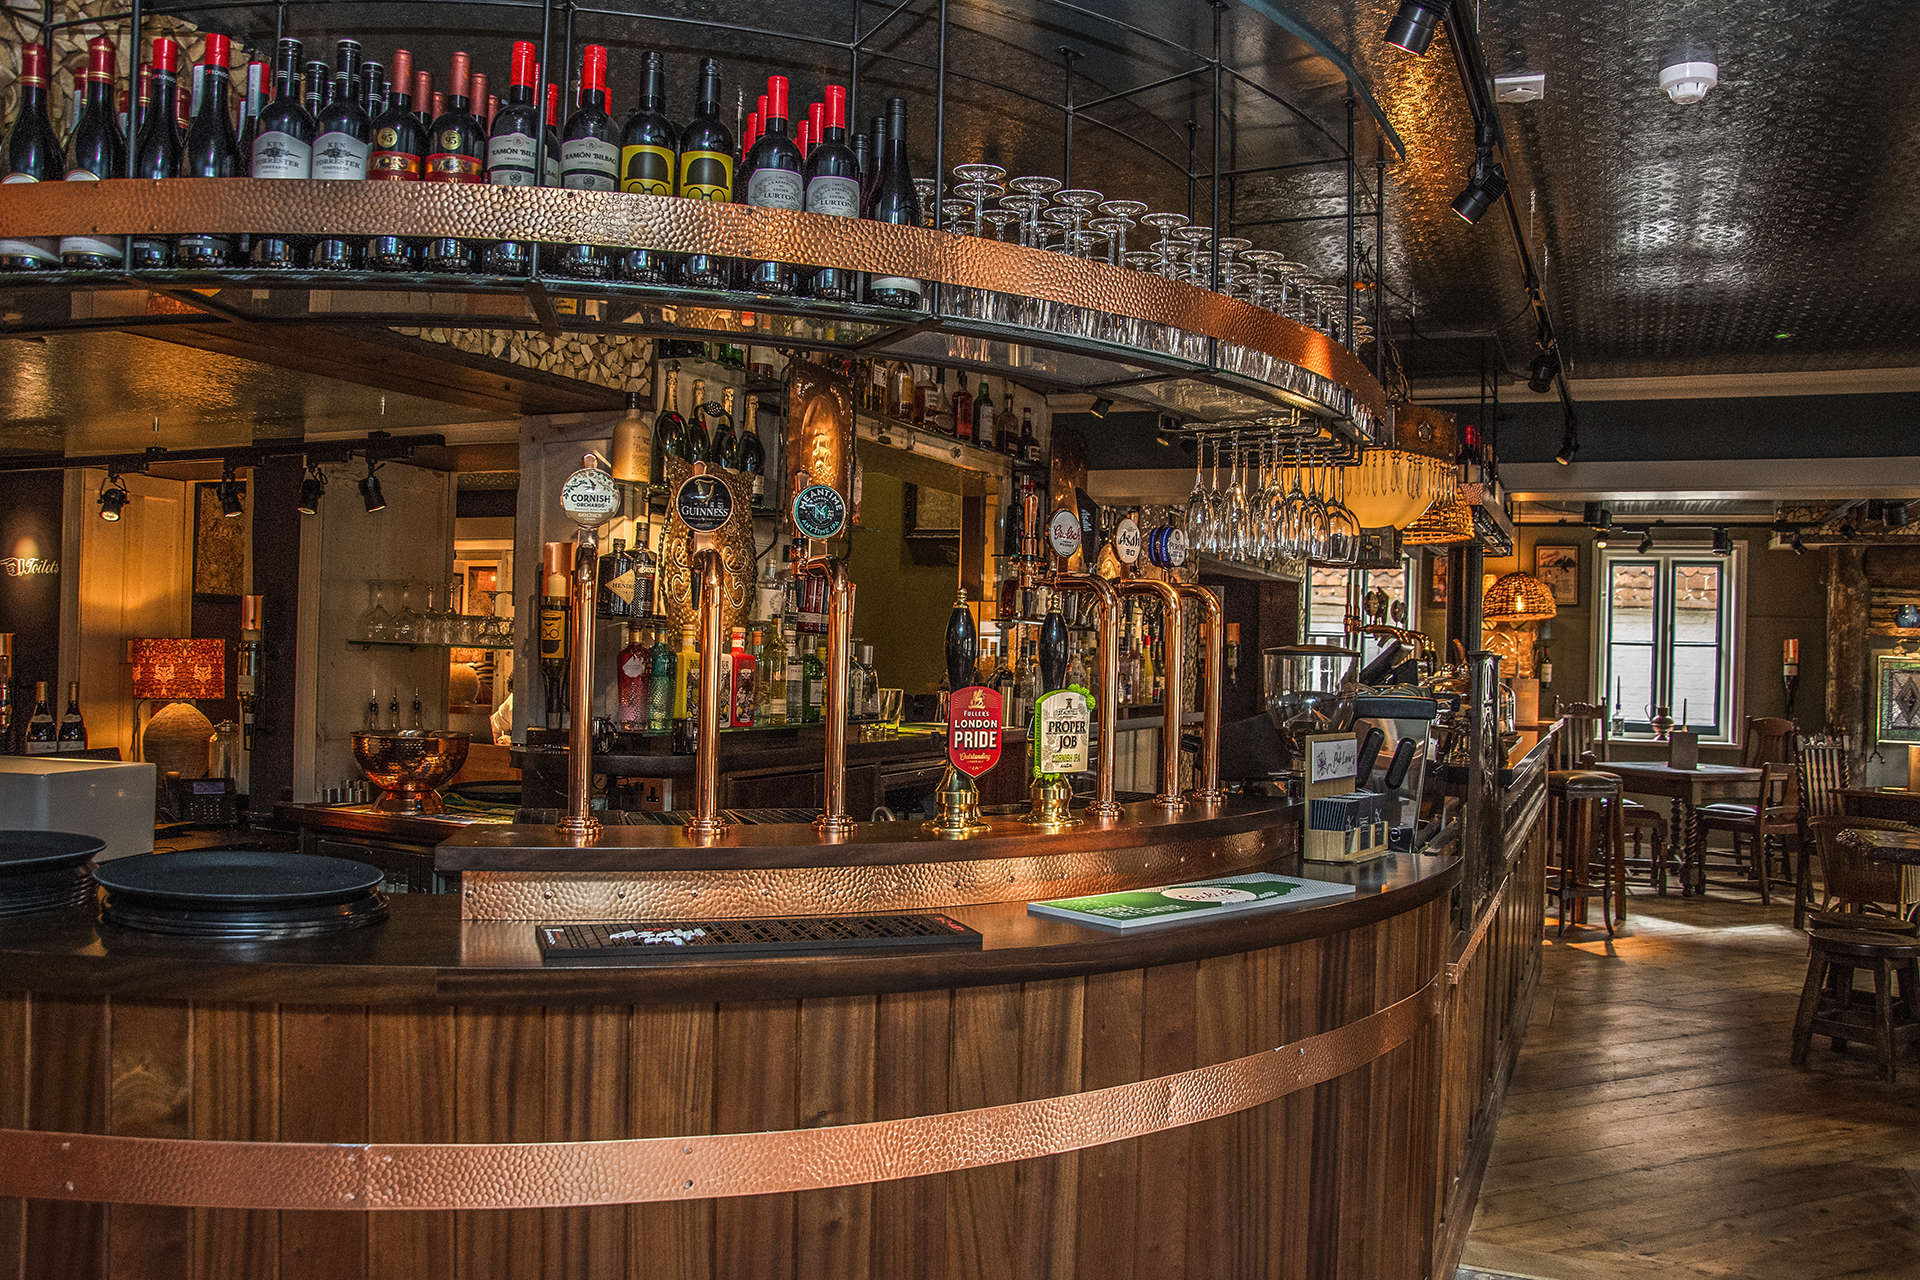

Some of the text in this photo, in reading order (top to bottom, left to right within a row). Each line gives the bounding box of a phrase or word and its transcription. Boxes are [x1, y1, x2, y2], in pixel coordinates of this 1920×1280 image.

[381, 134, 392, 142] 95
[444, 136, 457, 144] 95
[492, 146, 518, 156] RAMÓN
[255, 158, 300, 168] FORRESTER
[564, 152, 617, 164] RAMÓN BILBAO
[316, 159, 360, 169] FORRESTER
[763, 192, 796, 202] LURTON
[820, 200, 853, 208] LURTON
[571, 494, 611, 503] CORNISH
[799, 488, 843, 511] MEANTIME
[681, 505, 728, 517] GUINNESS
[802, 520, 840, 534] ANYTIME IPA
[24, 558, 59, 574] Toilets
[954, 720, 998, 729] LONDON
[1048, 721, 1086, 733] PROPER
[954, 731, 997, 749] PRIDE
[1057, 735, 1078, 752] JOB
[959, 752, 991, 762] Outstanding
[1052, 754, 1073, 762] CORNISH
